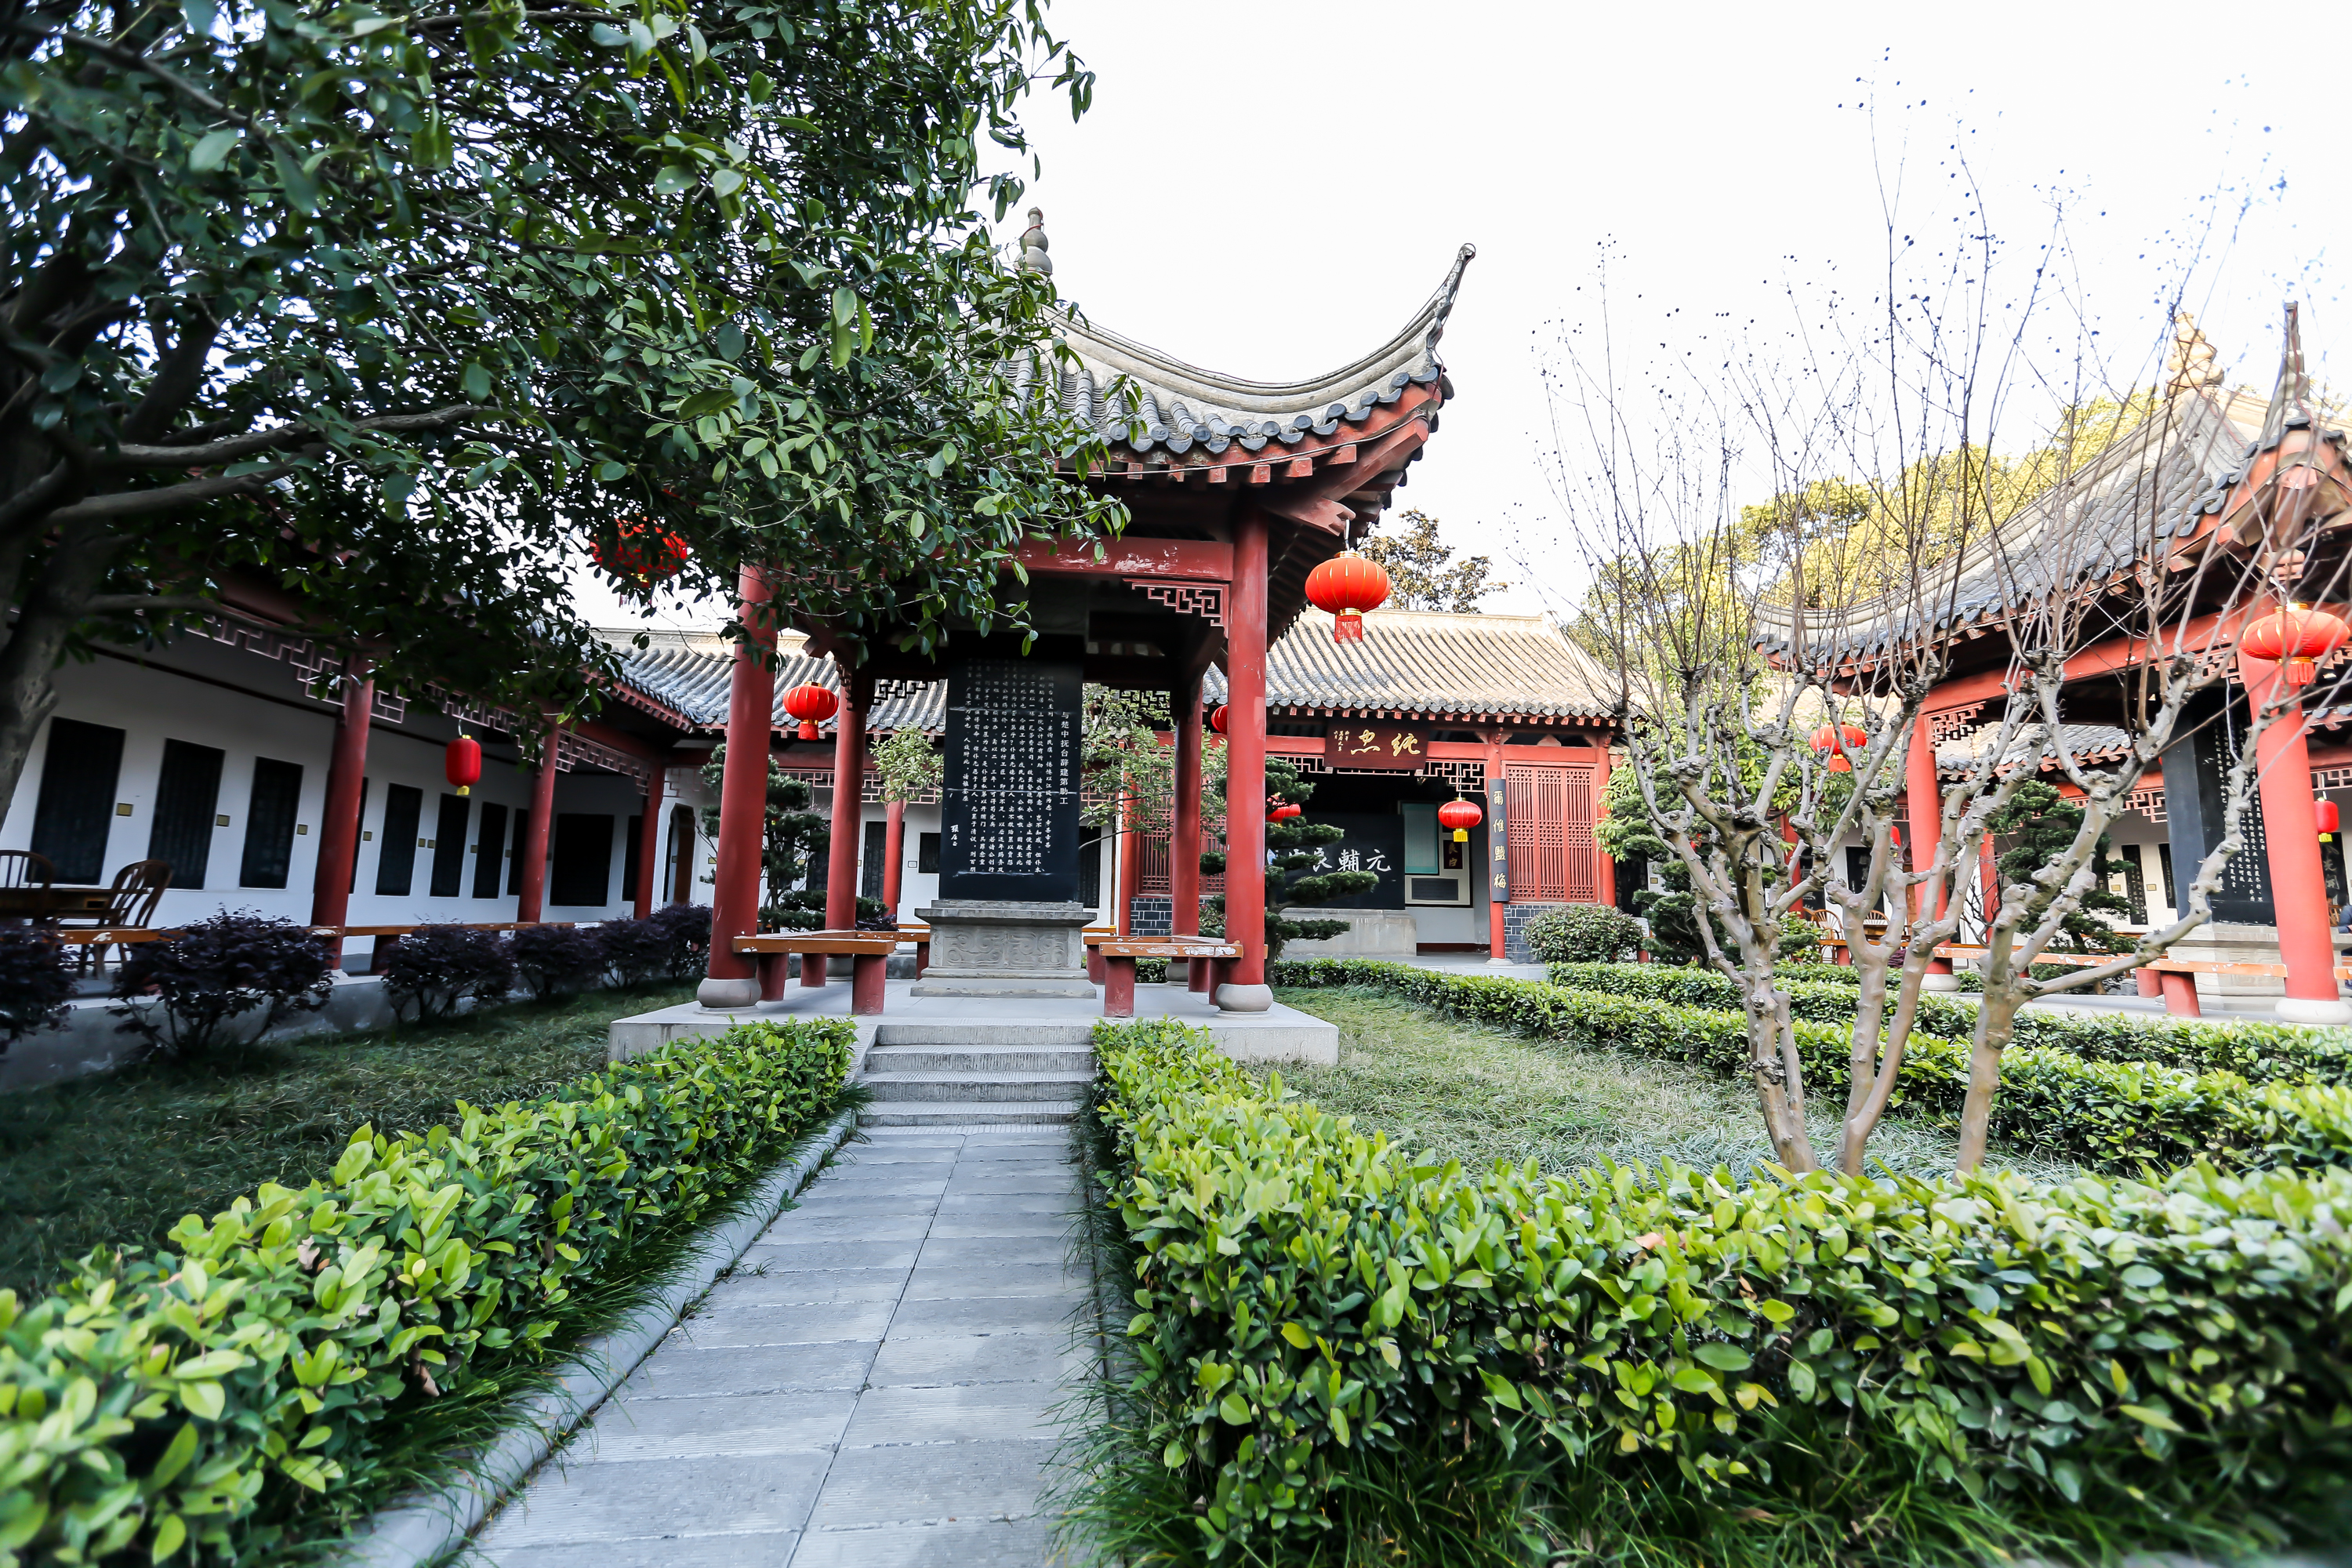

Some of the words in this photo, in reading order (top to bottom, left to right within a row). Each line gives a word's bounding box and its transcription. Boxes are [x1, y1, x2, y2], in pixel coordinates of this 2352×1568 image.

[1059, 711, 1070, 805] 与楚中抚台辞建第助工
